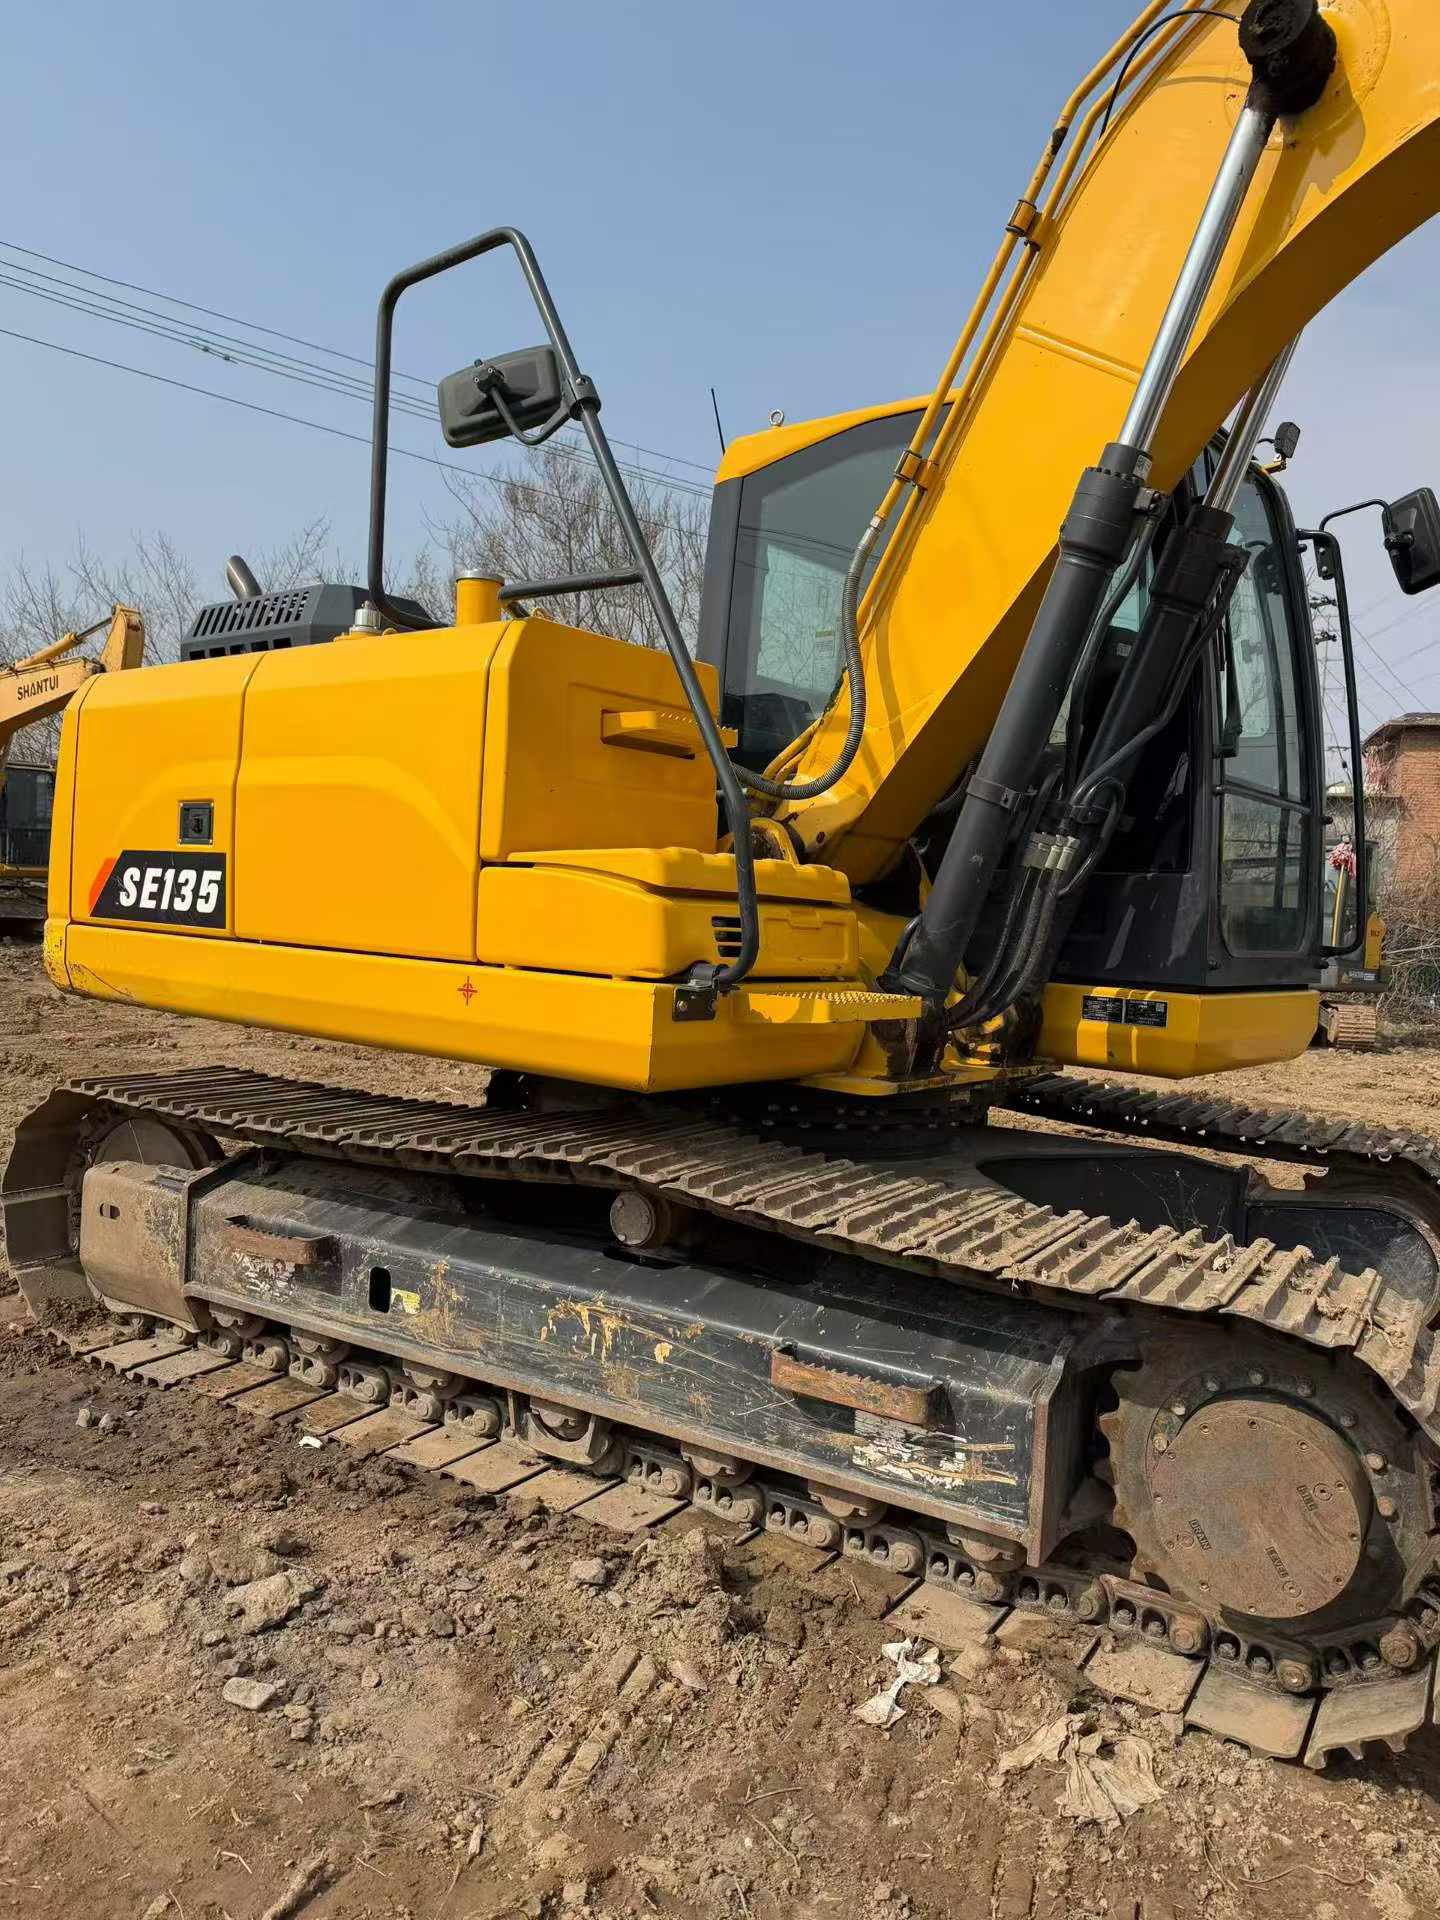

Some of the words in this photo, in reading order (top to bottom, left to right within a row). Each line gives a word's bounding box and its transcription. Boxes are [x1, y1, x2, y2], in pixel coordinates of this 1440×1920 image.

[17, 674, 59, 701] SHANTUI
[119, 866, 223, 914] SE135
[1188, 1518, 1213, 1551] DRAIN
